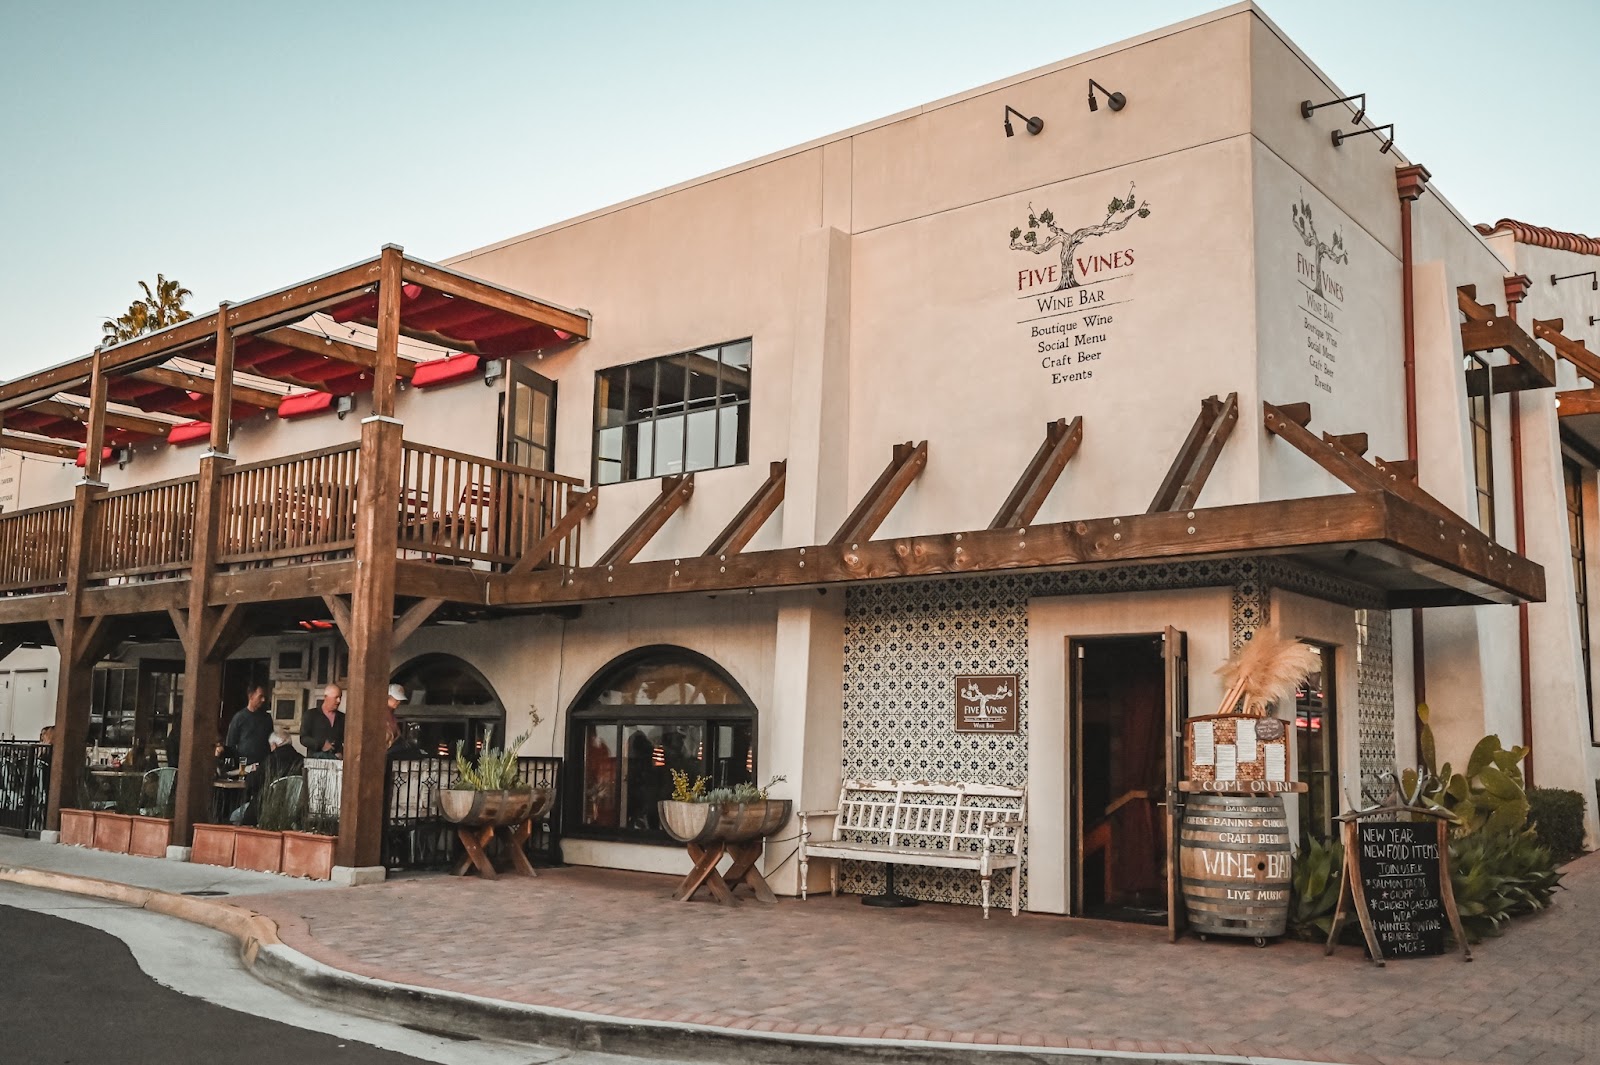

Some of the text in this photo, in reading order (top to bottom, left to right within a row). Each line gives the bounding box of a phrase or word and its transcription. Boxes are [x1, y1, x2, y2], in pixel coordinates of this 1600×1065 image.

[1018, 248, 1135, 290] FIVE VINES
[1297, 252, 1344, 302] FIVE VINES
[1037, 290, 1105, 312] WINE BAR
[1031, 314, 1113, 337] Boutique Wine
[1304, 317, 1337, 348] Boutique Wine
[1038, 333, 1106, 353] Social Menu
[1307, 336, 1335, 362] Social Menu
[1042, 351, 1102, 369] Craft Beer
[1309, 354, 1334, 378] Craft Beer
[1052, 369, 1092, 384] Events
[1314, 374, 1331, 393] Events
[964, 706, 1007, 714] FIVE VINES
[1203, 781, 1292, 792] COME ON IN!
[1214, 818, 1253, 827] PANINIS
[1219, 833, 1279, 844] CRAFT BEER
[1363, 829, 1386, 842] NEW
[1364, 844, 1439, 860] NEW FOOD ITEMS
[1202, 851, 1292, 878] WINE BAR
[1227, 890, 1282, 900] LIVE MUSIC
[1379, 921, 1410, 931] WINTER
